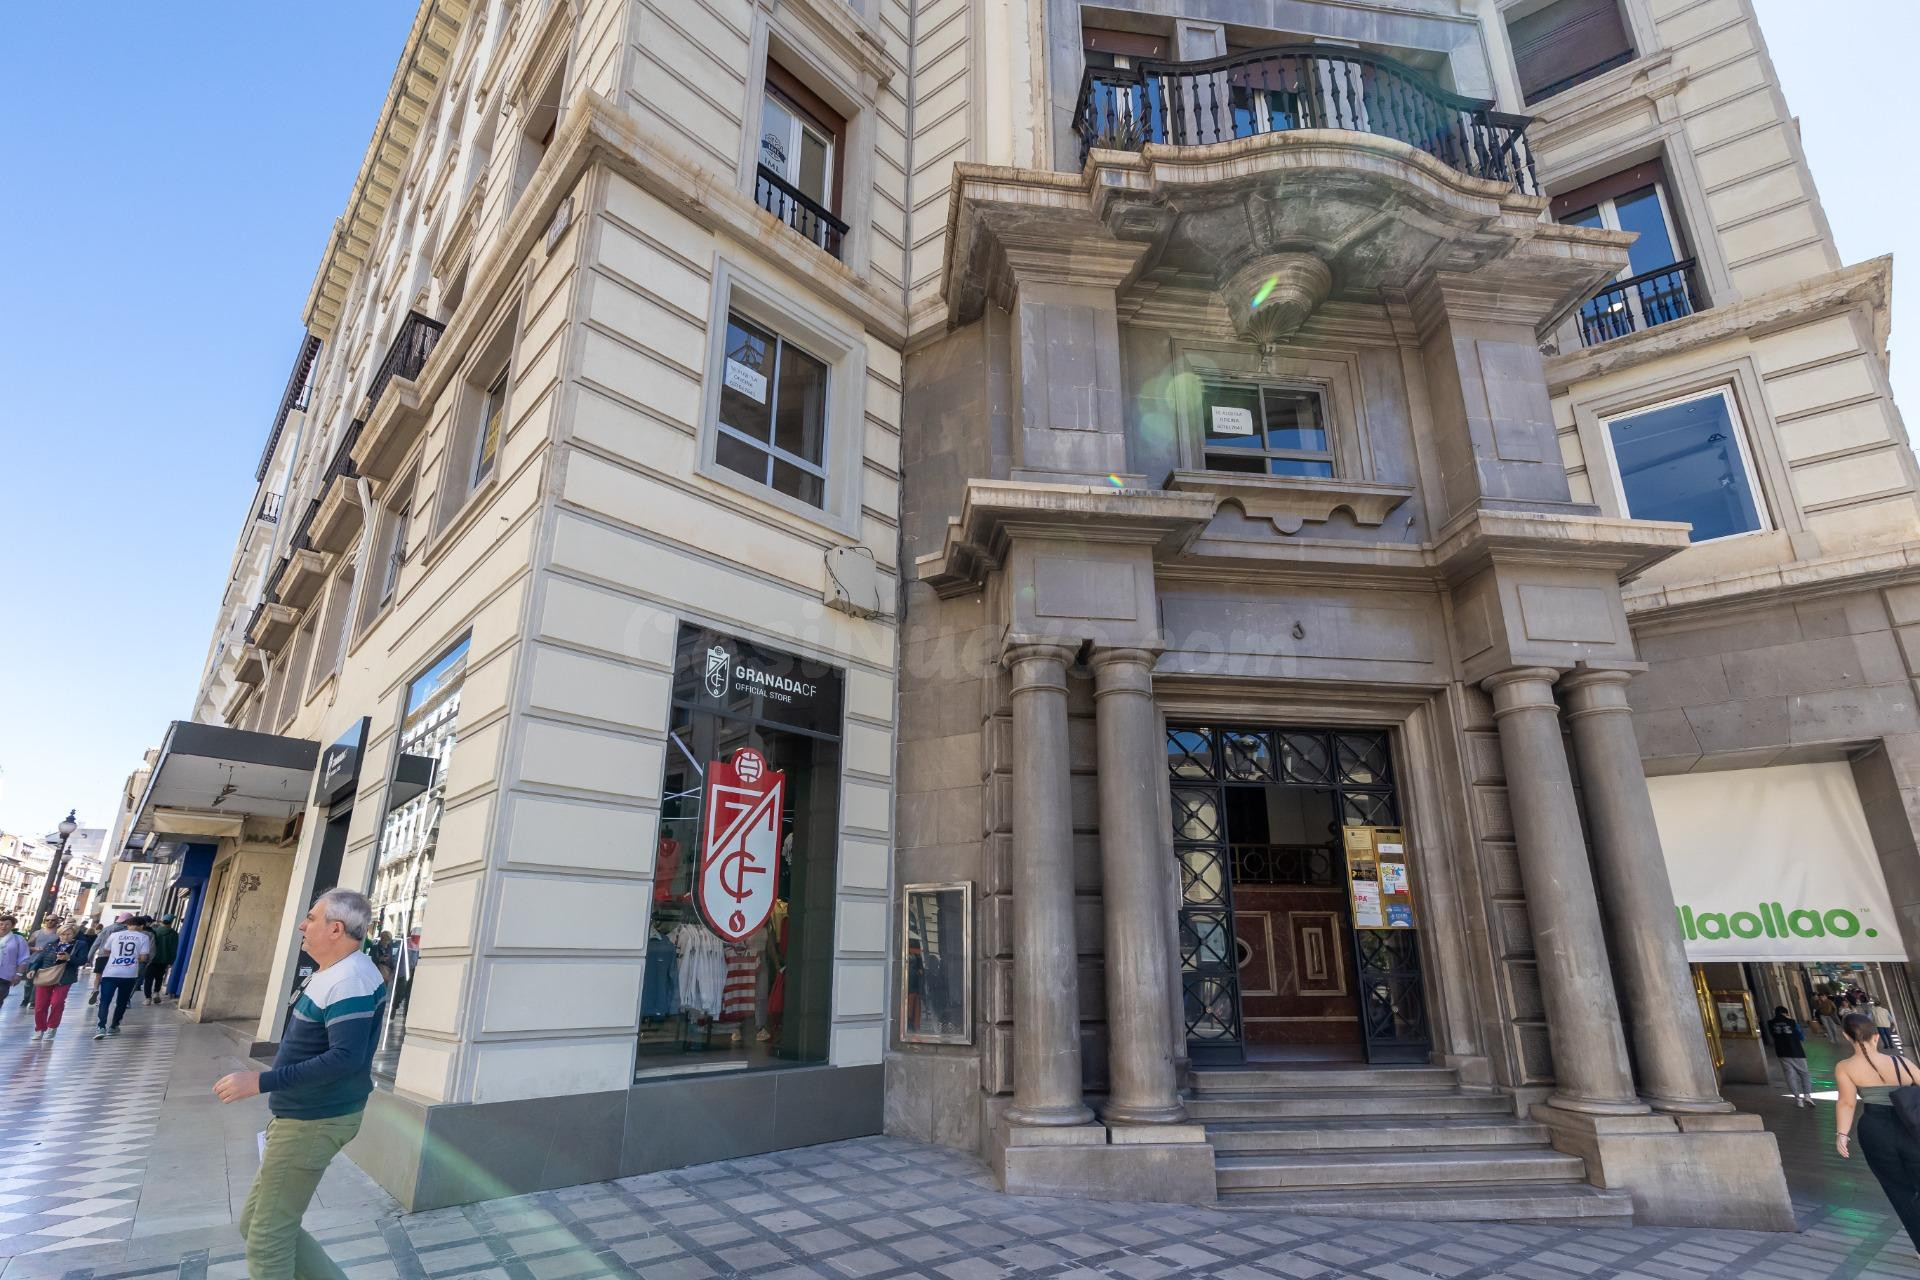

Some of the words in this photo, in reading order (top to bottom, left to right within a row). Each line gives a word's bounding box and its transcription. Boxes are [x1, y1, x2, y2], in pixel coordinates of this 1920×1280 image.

[735, 682, 768, 698] OFFICIAL
[769, 691, 792, 703] STORE
[118, 941, 136, 957] 19
